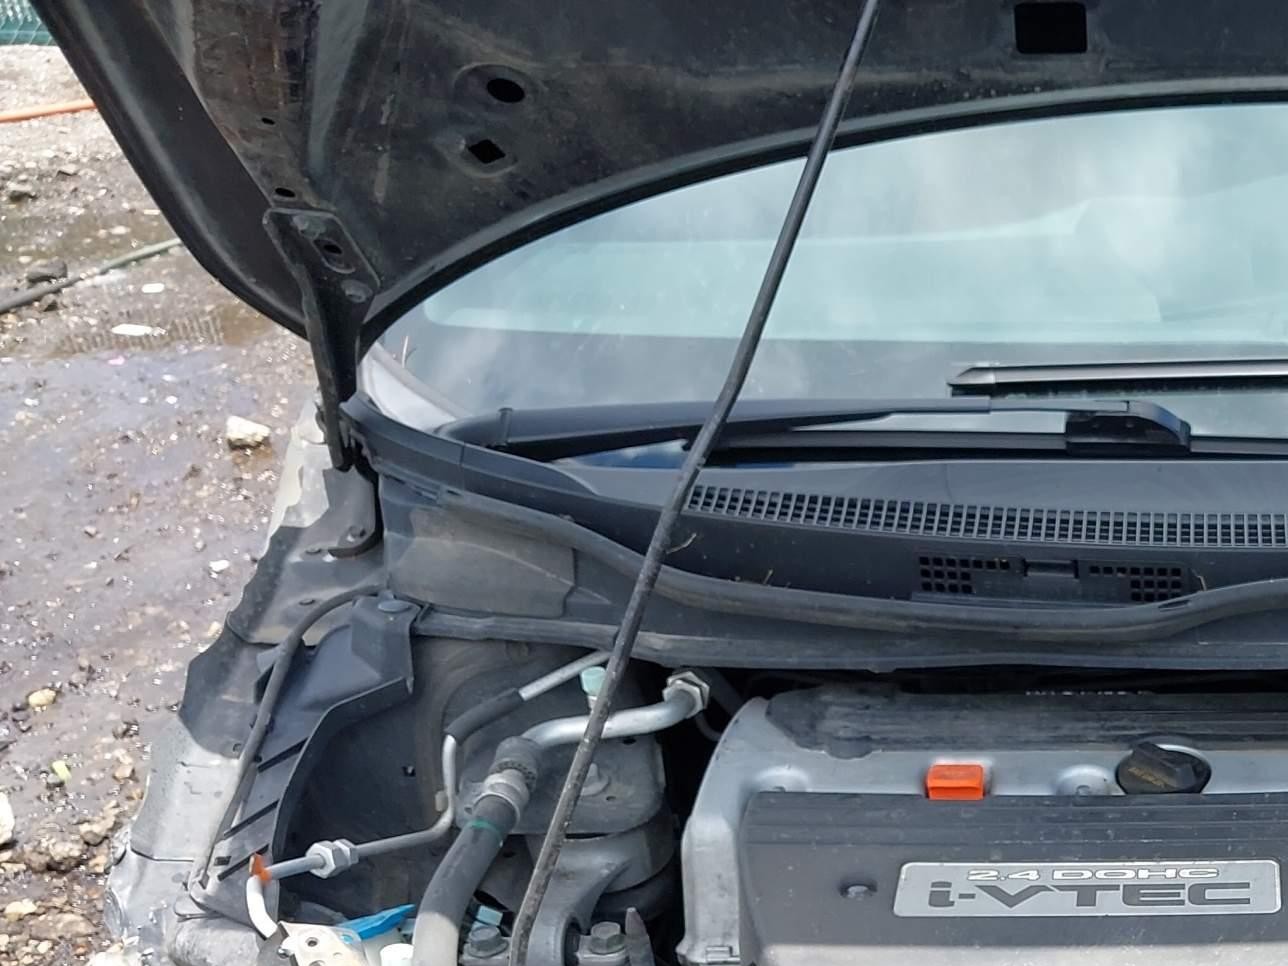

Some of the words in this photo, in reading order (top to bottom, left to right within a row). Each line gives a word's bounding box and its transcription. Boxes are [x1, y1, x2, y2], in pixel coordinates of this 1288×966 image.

[966, 869, 1040, 881] 2.4
[1051, 867, 1220, 880] DOHC
[928, 880, 1251, 908] i-VTEC
